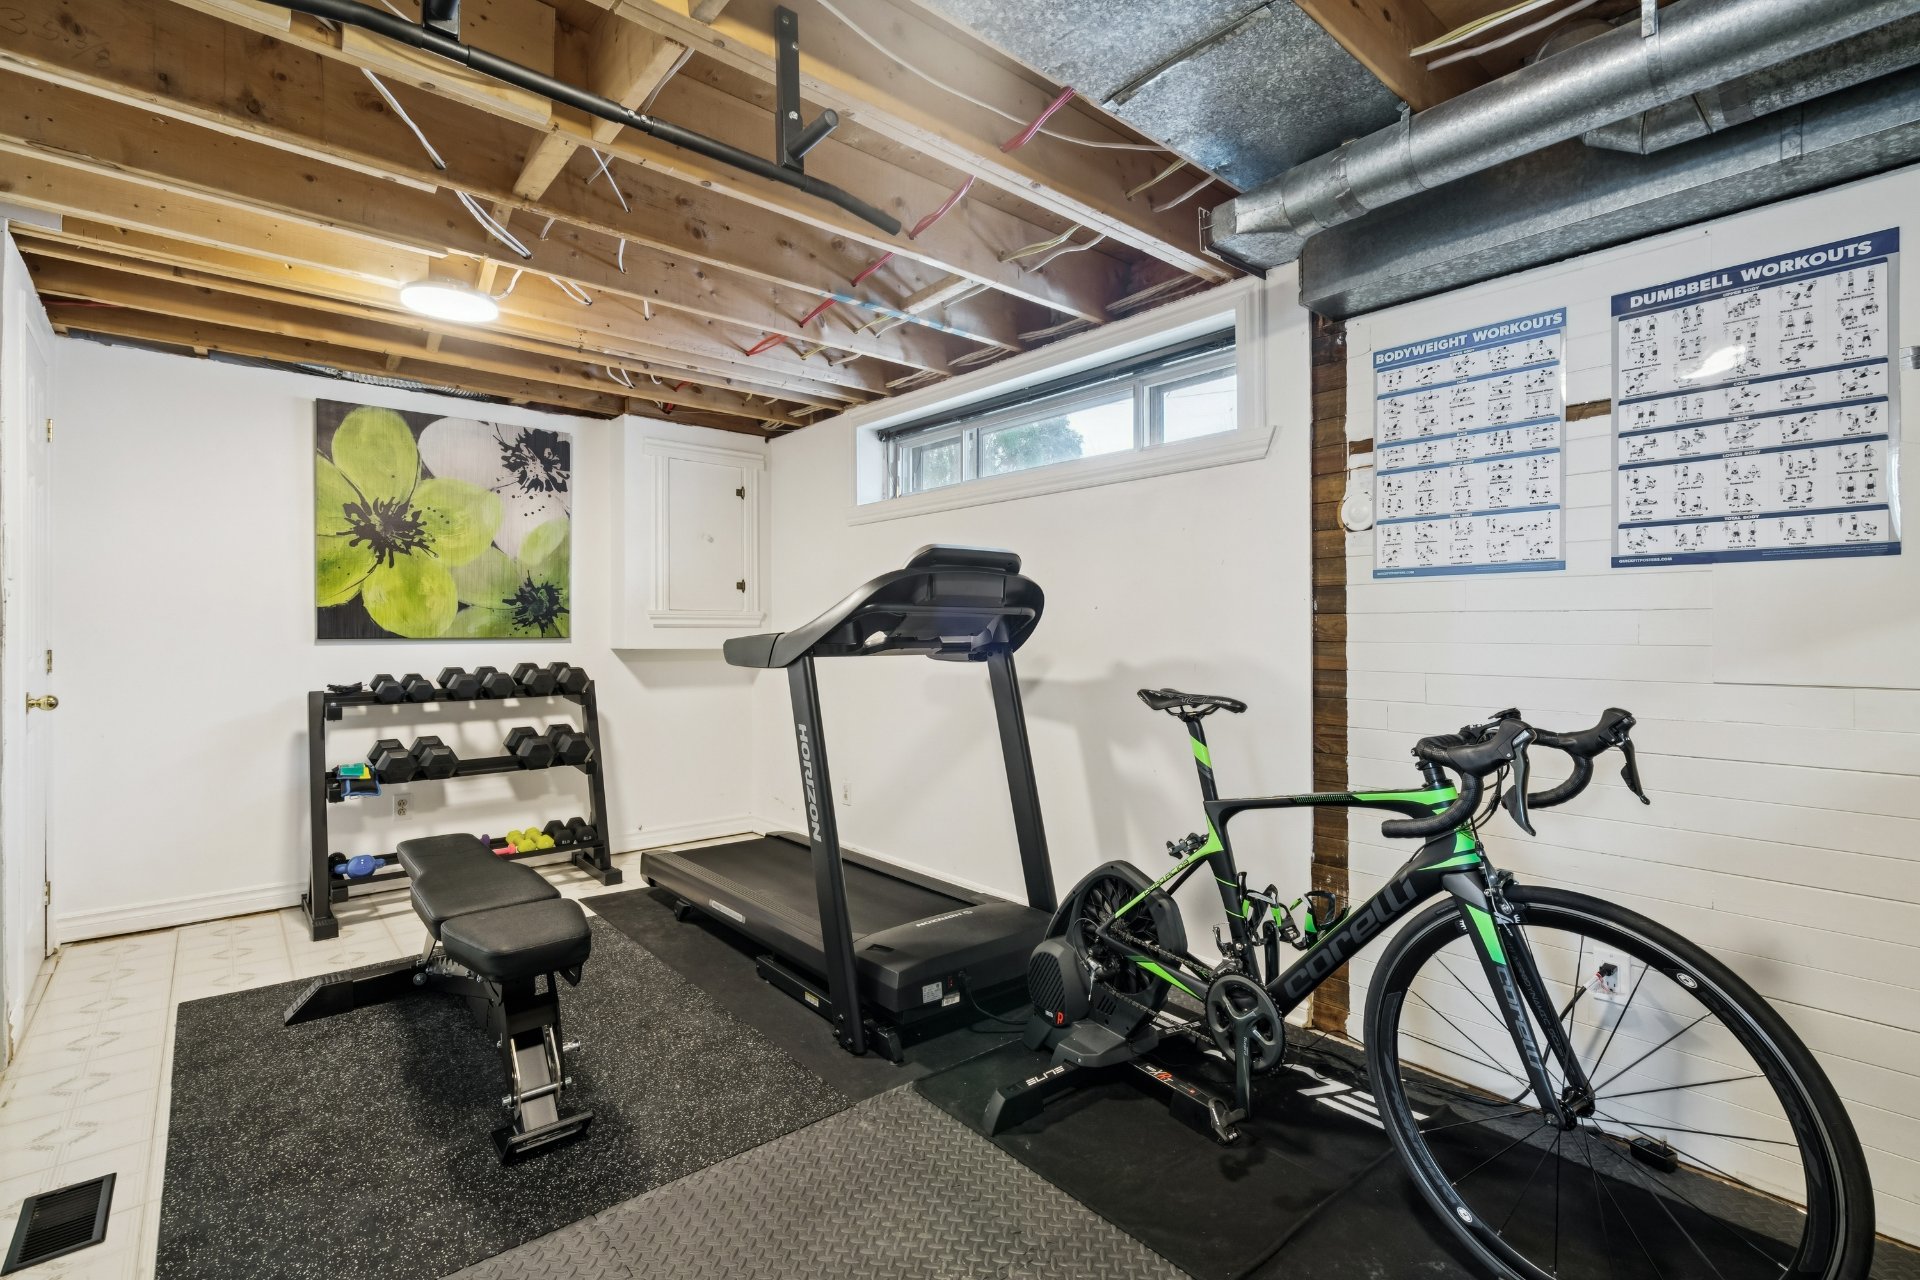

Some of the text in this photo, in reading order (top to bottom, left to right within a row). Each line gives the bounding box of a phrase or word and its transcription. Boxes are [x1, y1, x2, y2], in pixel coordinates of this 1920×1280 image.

[1630, 241, 1872, 308] DUMBBELL WORKOUTS
[1375, 312, 1563, 364] BODYWEIGHT WORKOUTS
[798, 723, 822, 843] HORIZON
[1283, 878, 1418, 999] corelli
[1496, 965, 1544, 1070] corelli
